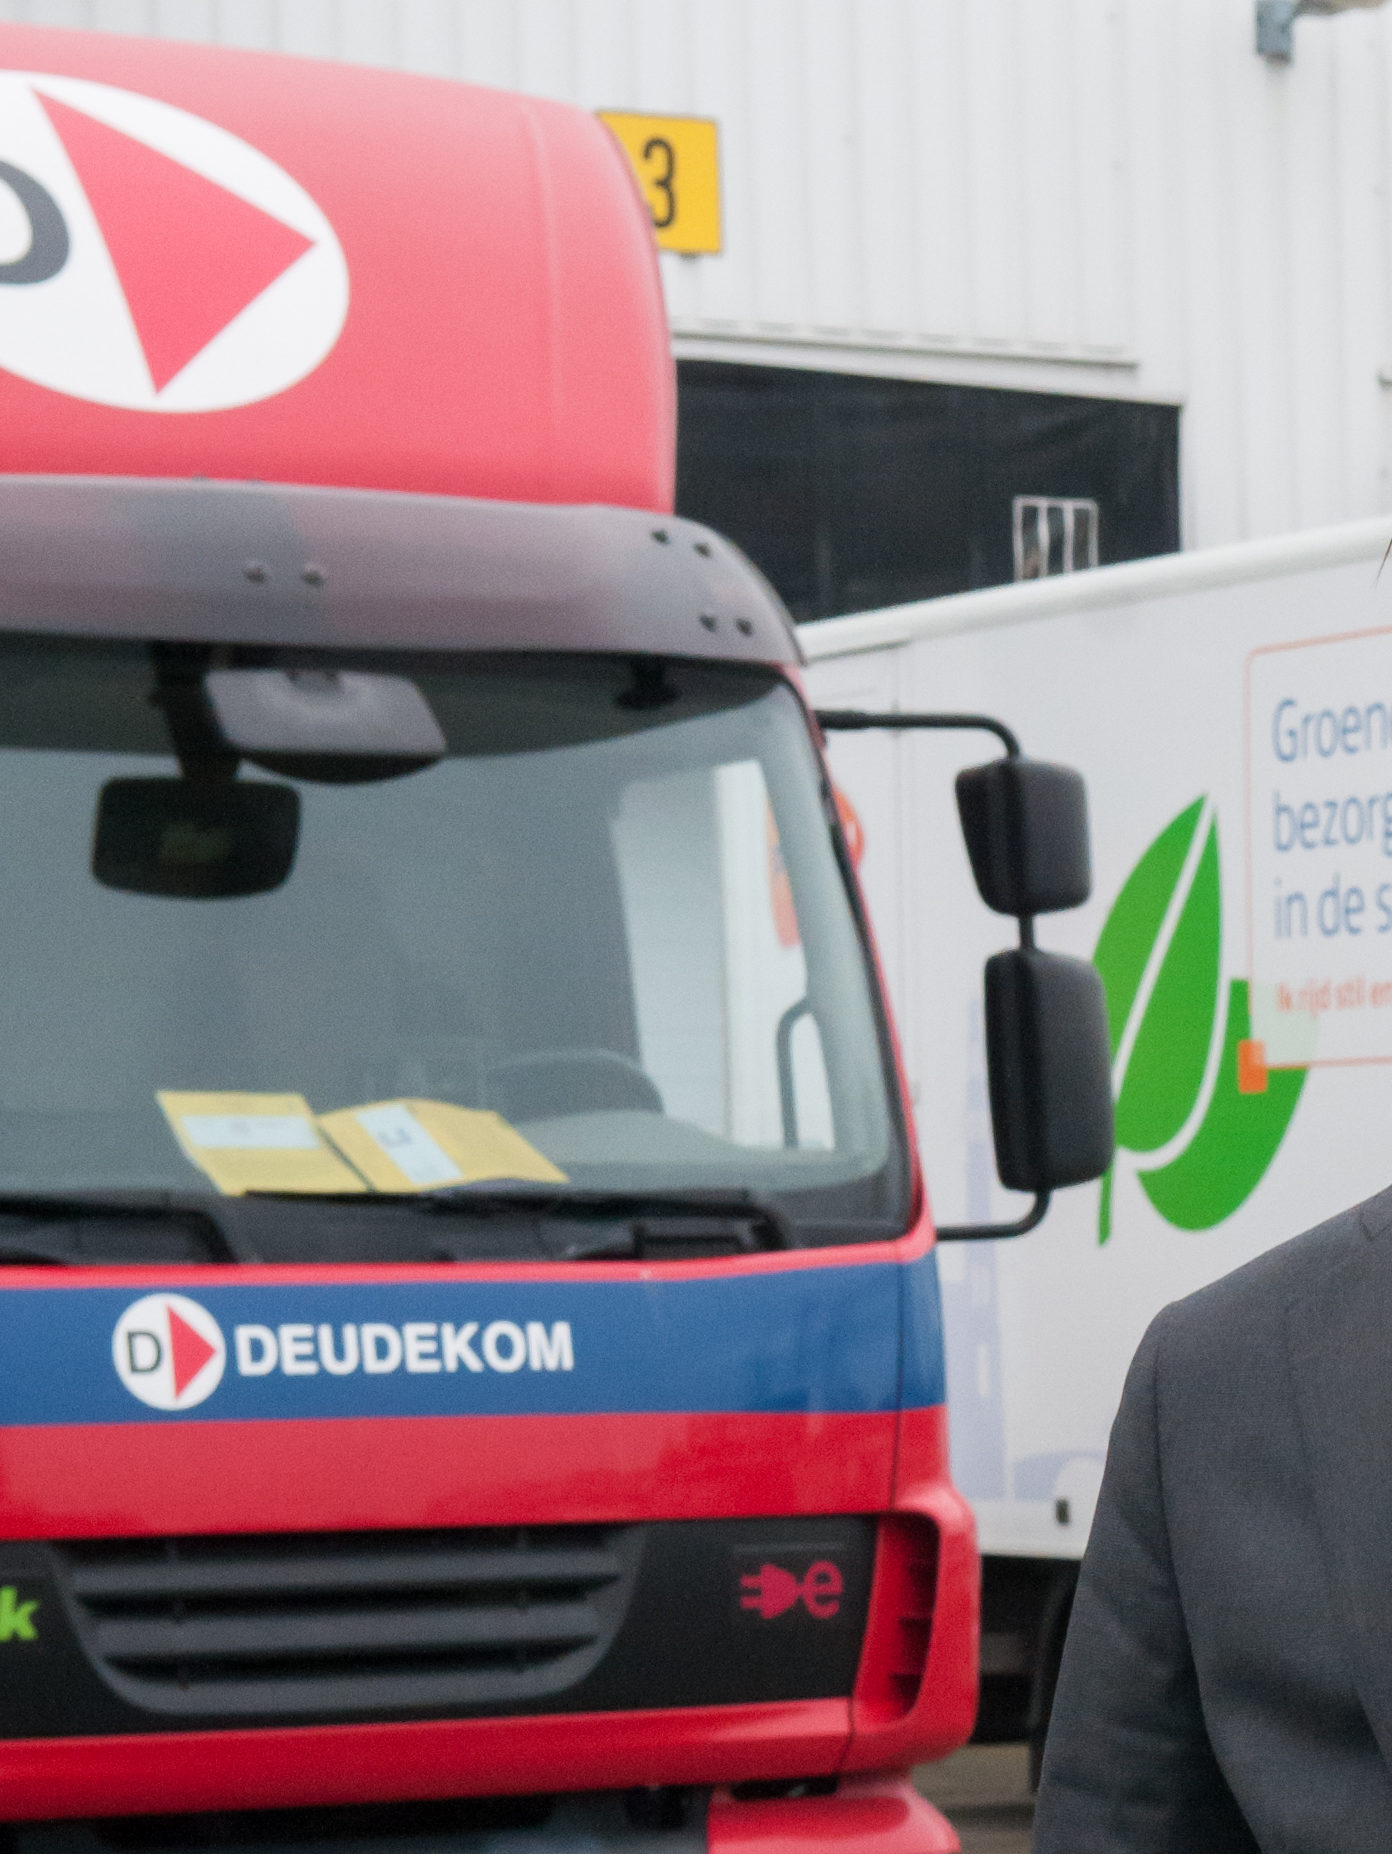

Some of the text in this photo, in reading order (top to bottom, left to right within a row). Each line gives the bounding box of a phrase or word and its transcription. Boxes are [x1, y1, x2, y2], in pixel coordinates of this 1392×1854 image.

[643, 137, 675, 230] 3
[1275, 877, 1308, 938] in
[1318, 871, 1365, 936] de
[235, 1320, 575, 1377] DEUDEKOM
